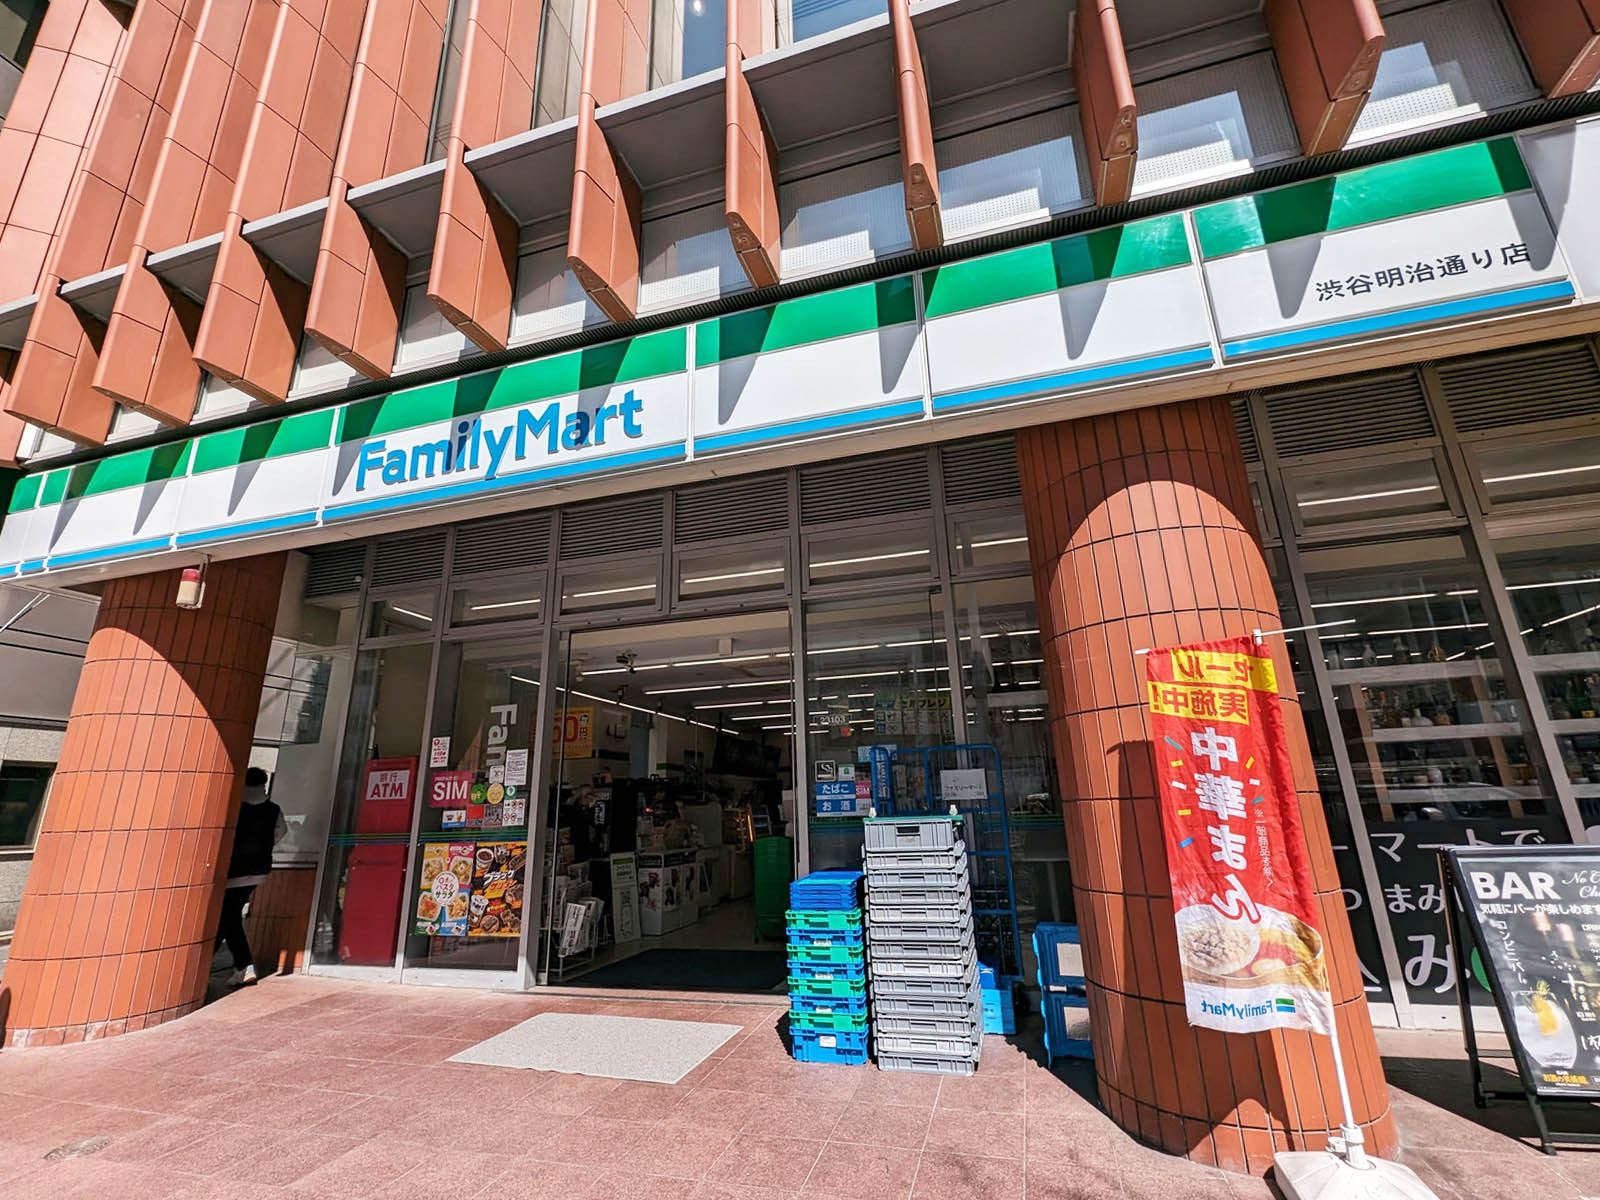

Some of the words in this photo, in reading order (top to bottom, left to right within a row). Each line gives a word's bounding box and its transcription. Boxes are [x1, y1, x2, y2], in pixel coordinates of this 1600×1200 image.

[1315, 242, 1531, 301] 渋谷明治通り店
[355, 389, 643, 491] FamilyMart
[370, 781, 404, 799] ATM
[433, 780, 469, 801] SIM
[822, 784, 849, 794] たばこ
[1470, 872, 1562, 900] BAR
